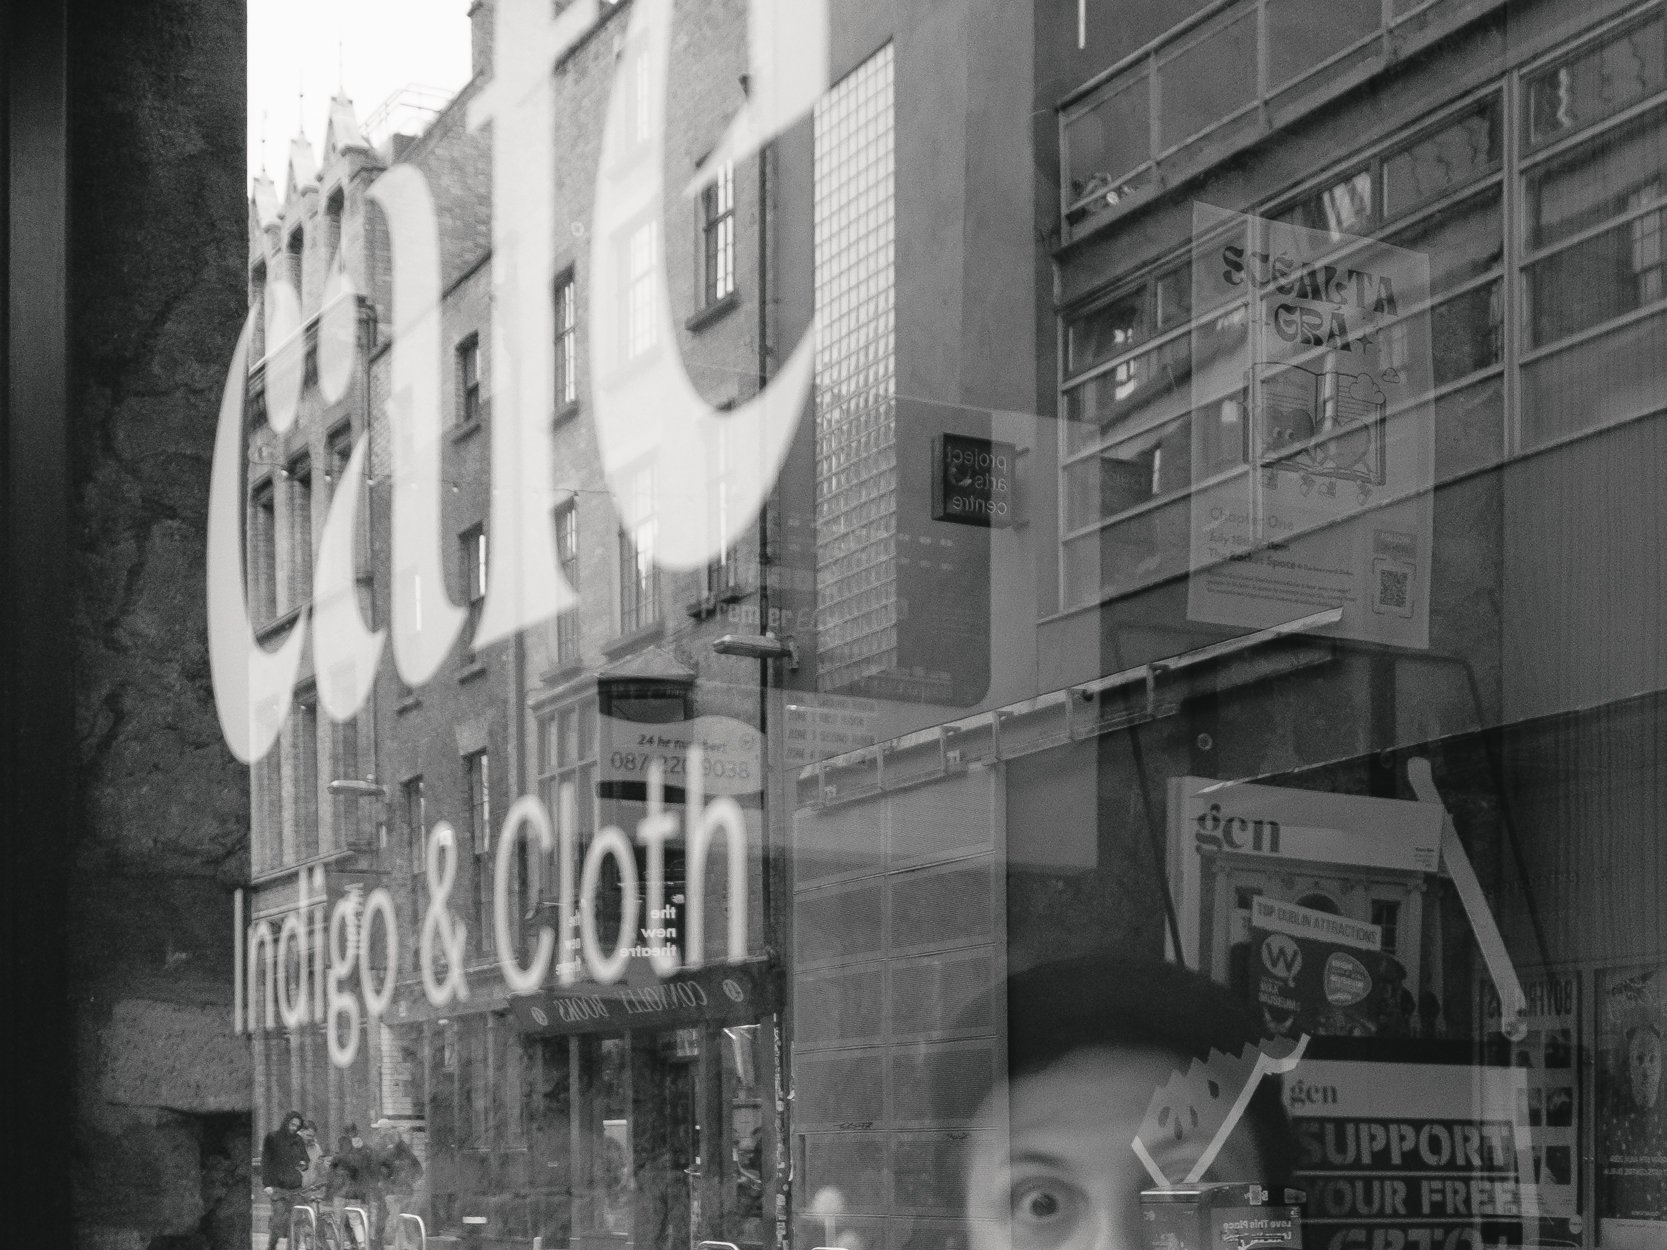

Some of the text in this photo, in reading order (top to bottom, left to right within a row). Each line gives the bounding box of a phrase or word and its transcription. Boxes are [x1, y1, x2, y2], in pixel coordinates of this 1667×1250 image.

[638, 733, 655, 747] 24
[674, 738, 728, 754] nubers
[611, 751, 650, 773] 087
[1195, 803, 1281, 854] gcn
[234, 742, 749, 1069] Indigo & Cloth
[1313, 916, 1379, 944] ATTRACTIONS
[1289, 1079, 1339, 1109] gcn
[1297, 1122, 1511, 1167] SUPPORT
[1421, 1180, 1518, 1216] FREE
